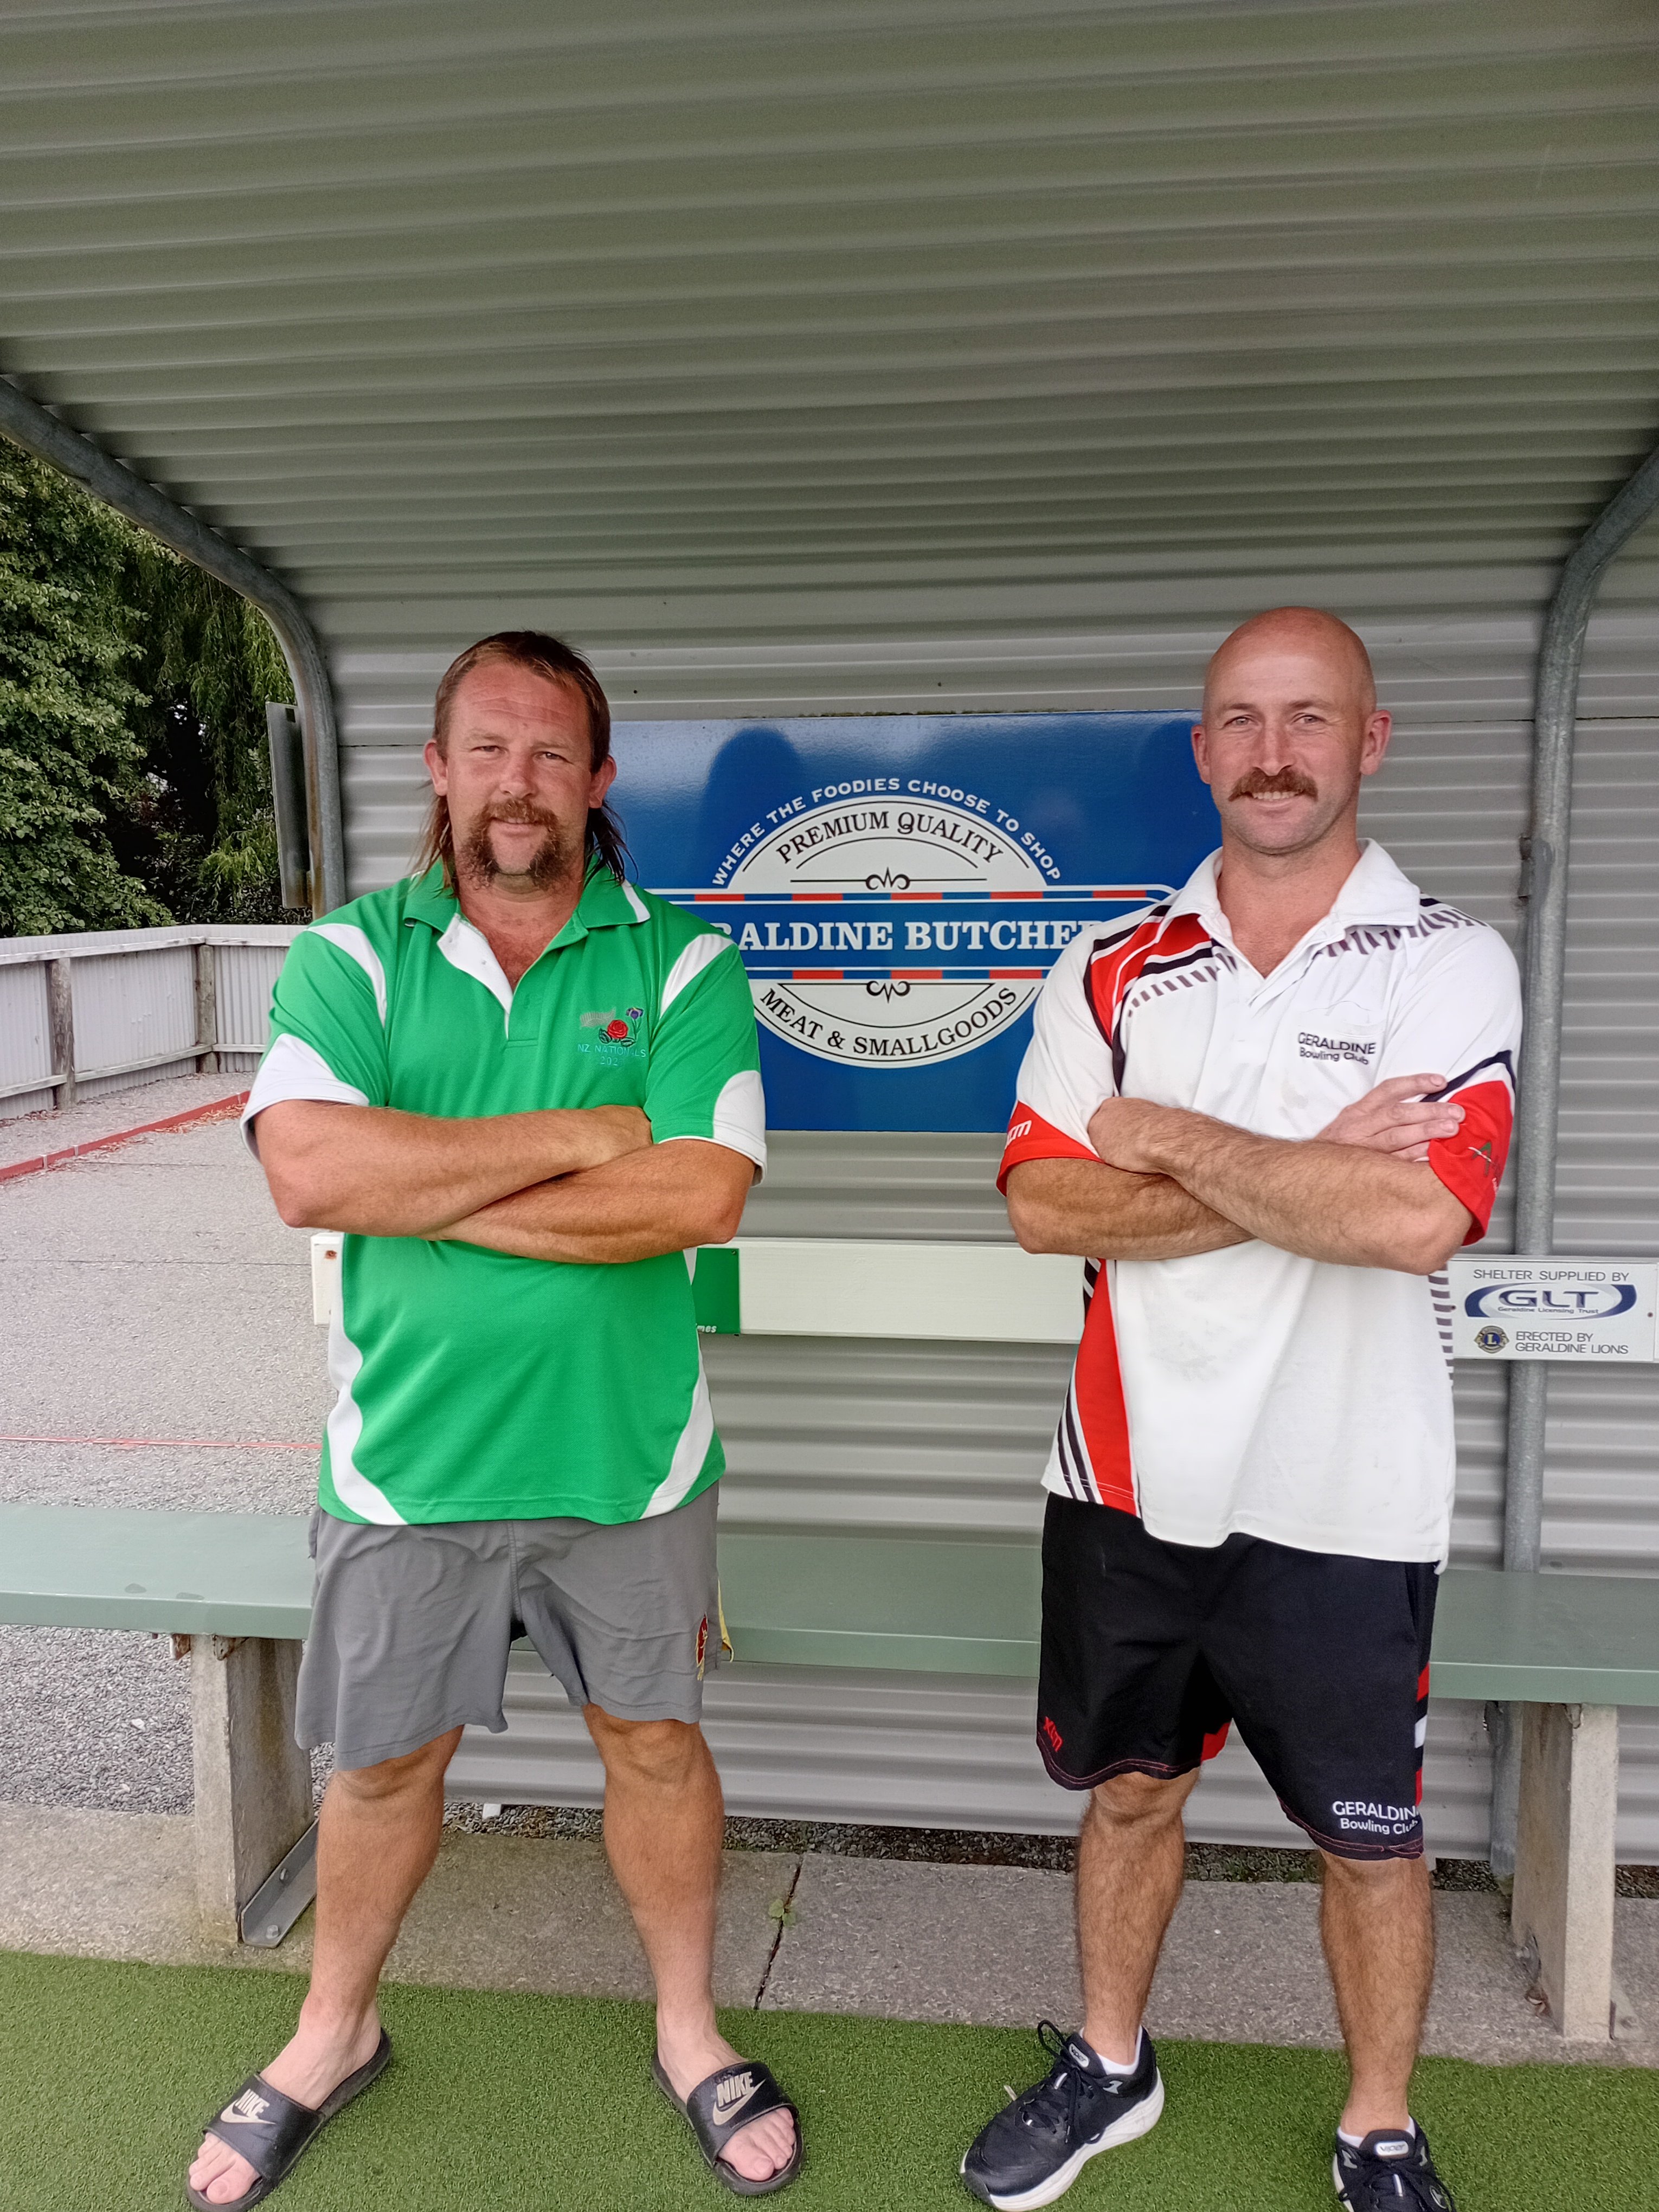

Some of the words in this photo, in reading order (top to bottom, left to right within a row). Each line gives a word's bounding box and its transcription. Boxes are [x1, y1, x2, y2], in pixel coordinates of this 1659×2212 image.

[712, 822, 765, 886] WHERE
[766, 796, 806, 824] THE
[811, 778, 900, 803] FOODIES
[908, 779, 991, 814] CHOOSE
[996, 809, 1019, 832] TO
[1020, 832, 1061, 880] SHOP
[776, 811, 889, 864] PREMIUM
[897, 812, 1004, 863] QUALITY
[904, 920, 1102, 951] BUTCHE
[760, 988, 823, 1039] MEAT
[827, 1031, 846, 1050] &
[853, 987, 1017, 1056] SMALLGOODS
[577, 1044, 590, 1053] NZ
[594, 1045, 646, 1058] NATIONALS
[1298, 1032, 1377, 1054] GERALDINE
[1300, 1046, 1340, 1062] Bowling
[1343, 1052, 1369, 1065] Club
[1473, 1269, 1533, 1280] SHELTER
[1539, 1271, 1606, 1281] SUPPLIED
[1612, 1272, 1630, 1282] BY
[1498, 1290, 1599, 1308] GLT
[1516, 1331, 1572, 1342] ERECTED
[1577, 1333, 1593, 1342] BY
[1515, 1342, 1586, 1353] GERALDINE
[1591, 1344, 1629, 1354] LIONS
[1332, 1801, 1419, 1821] GERALDIN
[1340, 1818, 1390, 1835] Bowling
[717, 2071, 755, 2107] NIKE
[235, 2088, 270, 2120] NIKE
